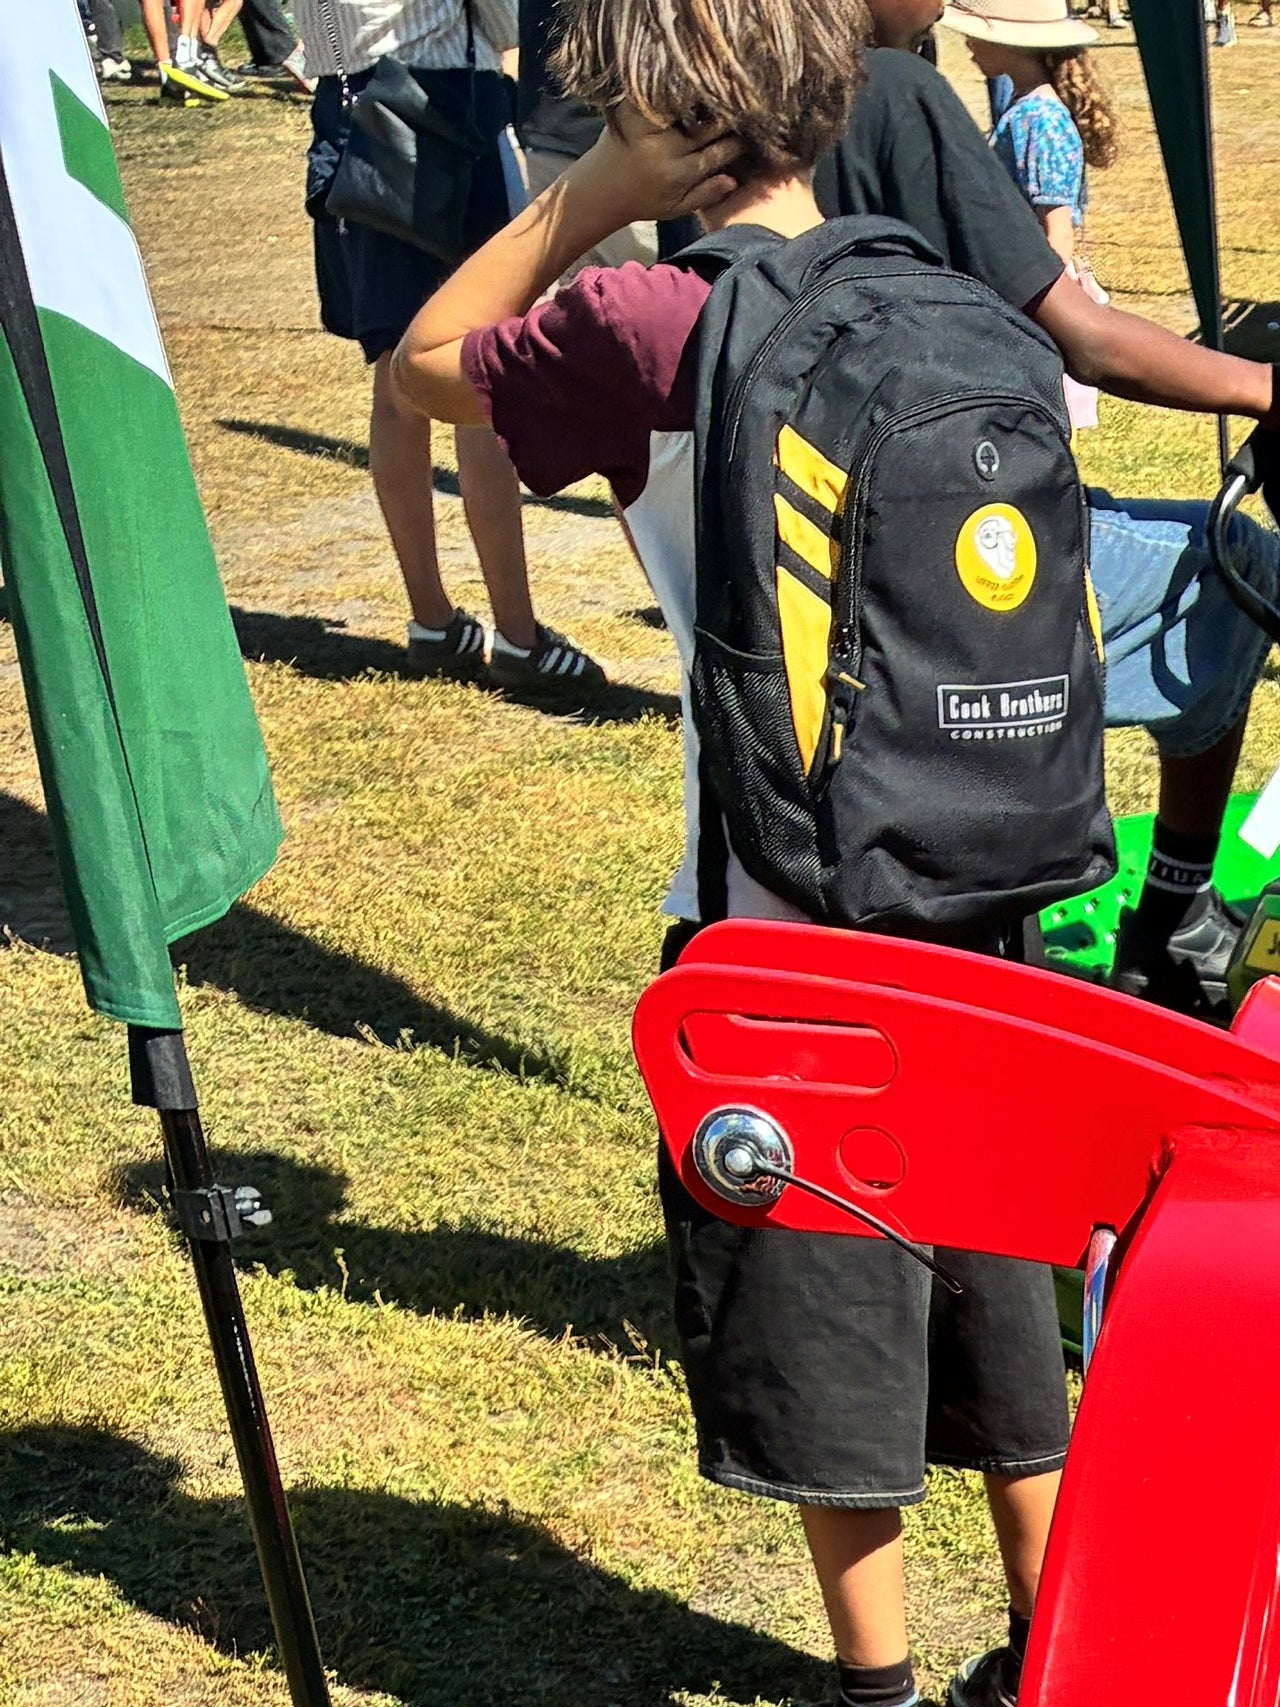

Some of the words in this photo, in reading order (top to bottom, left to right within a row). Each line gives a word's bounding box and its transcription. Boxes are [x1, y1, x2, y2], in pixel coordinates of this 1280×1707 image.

[949, 694, 991, 719] Cook
[1000, 689, 1063, 718] Brothers
[950, 721, 1062, 740] CONSTRUCTION
